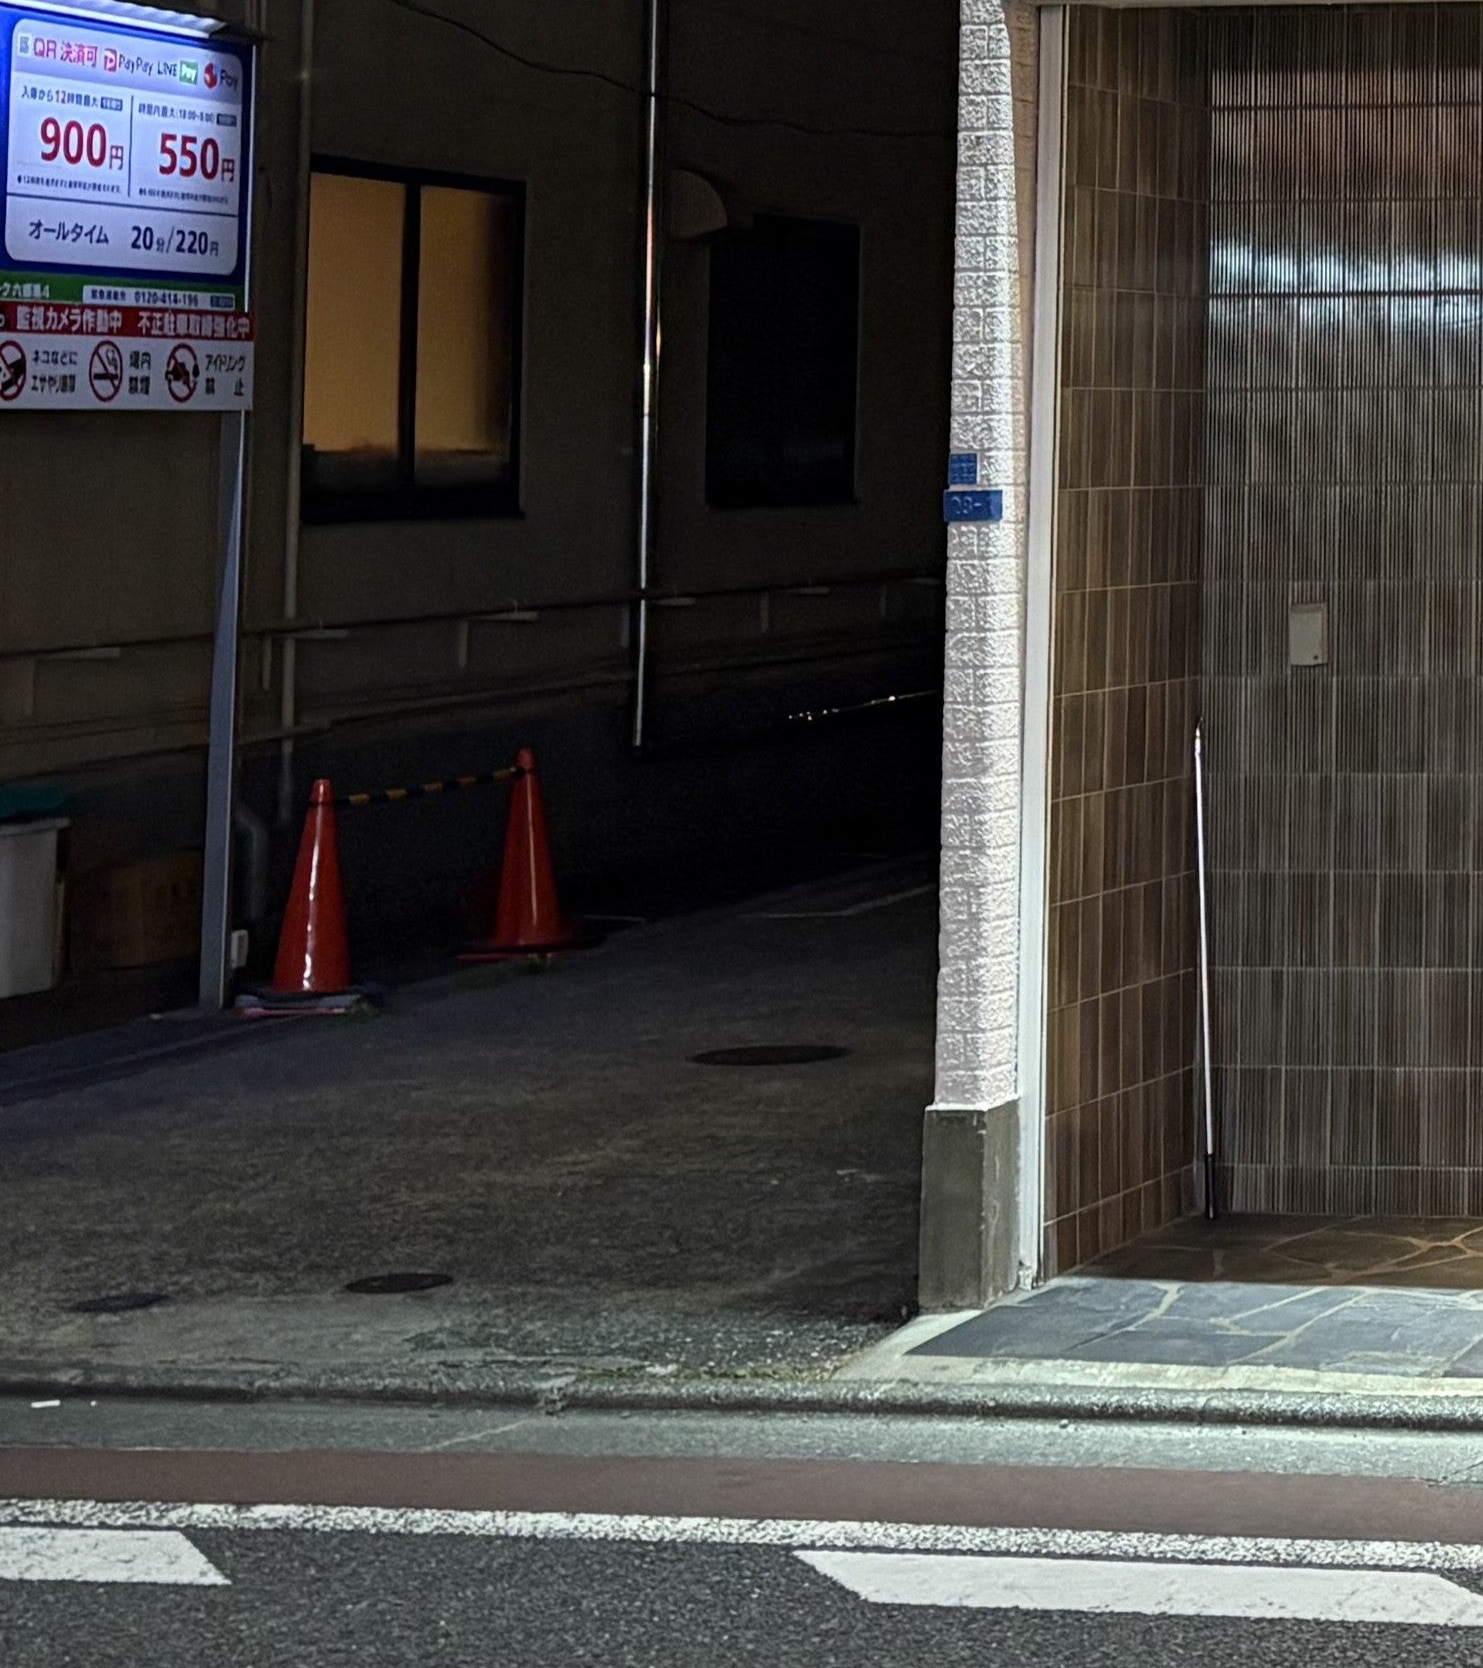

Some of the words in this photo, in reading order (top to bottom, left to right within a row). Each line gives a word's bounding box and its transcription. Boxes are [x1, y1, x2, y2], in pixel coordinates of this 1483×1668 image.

[40, 116, 124, 171] 900円
[159, 132, 235, 182] 550円
[29, 219, 110, 245] オールタイム
